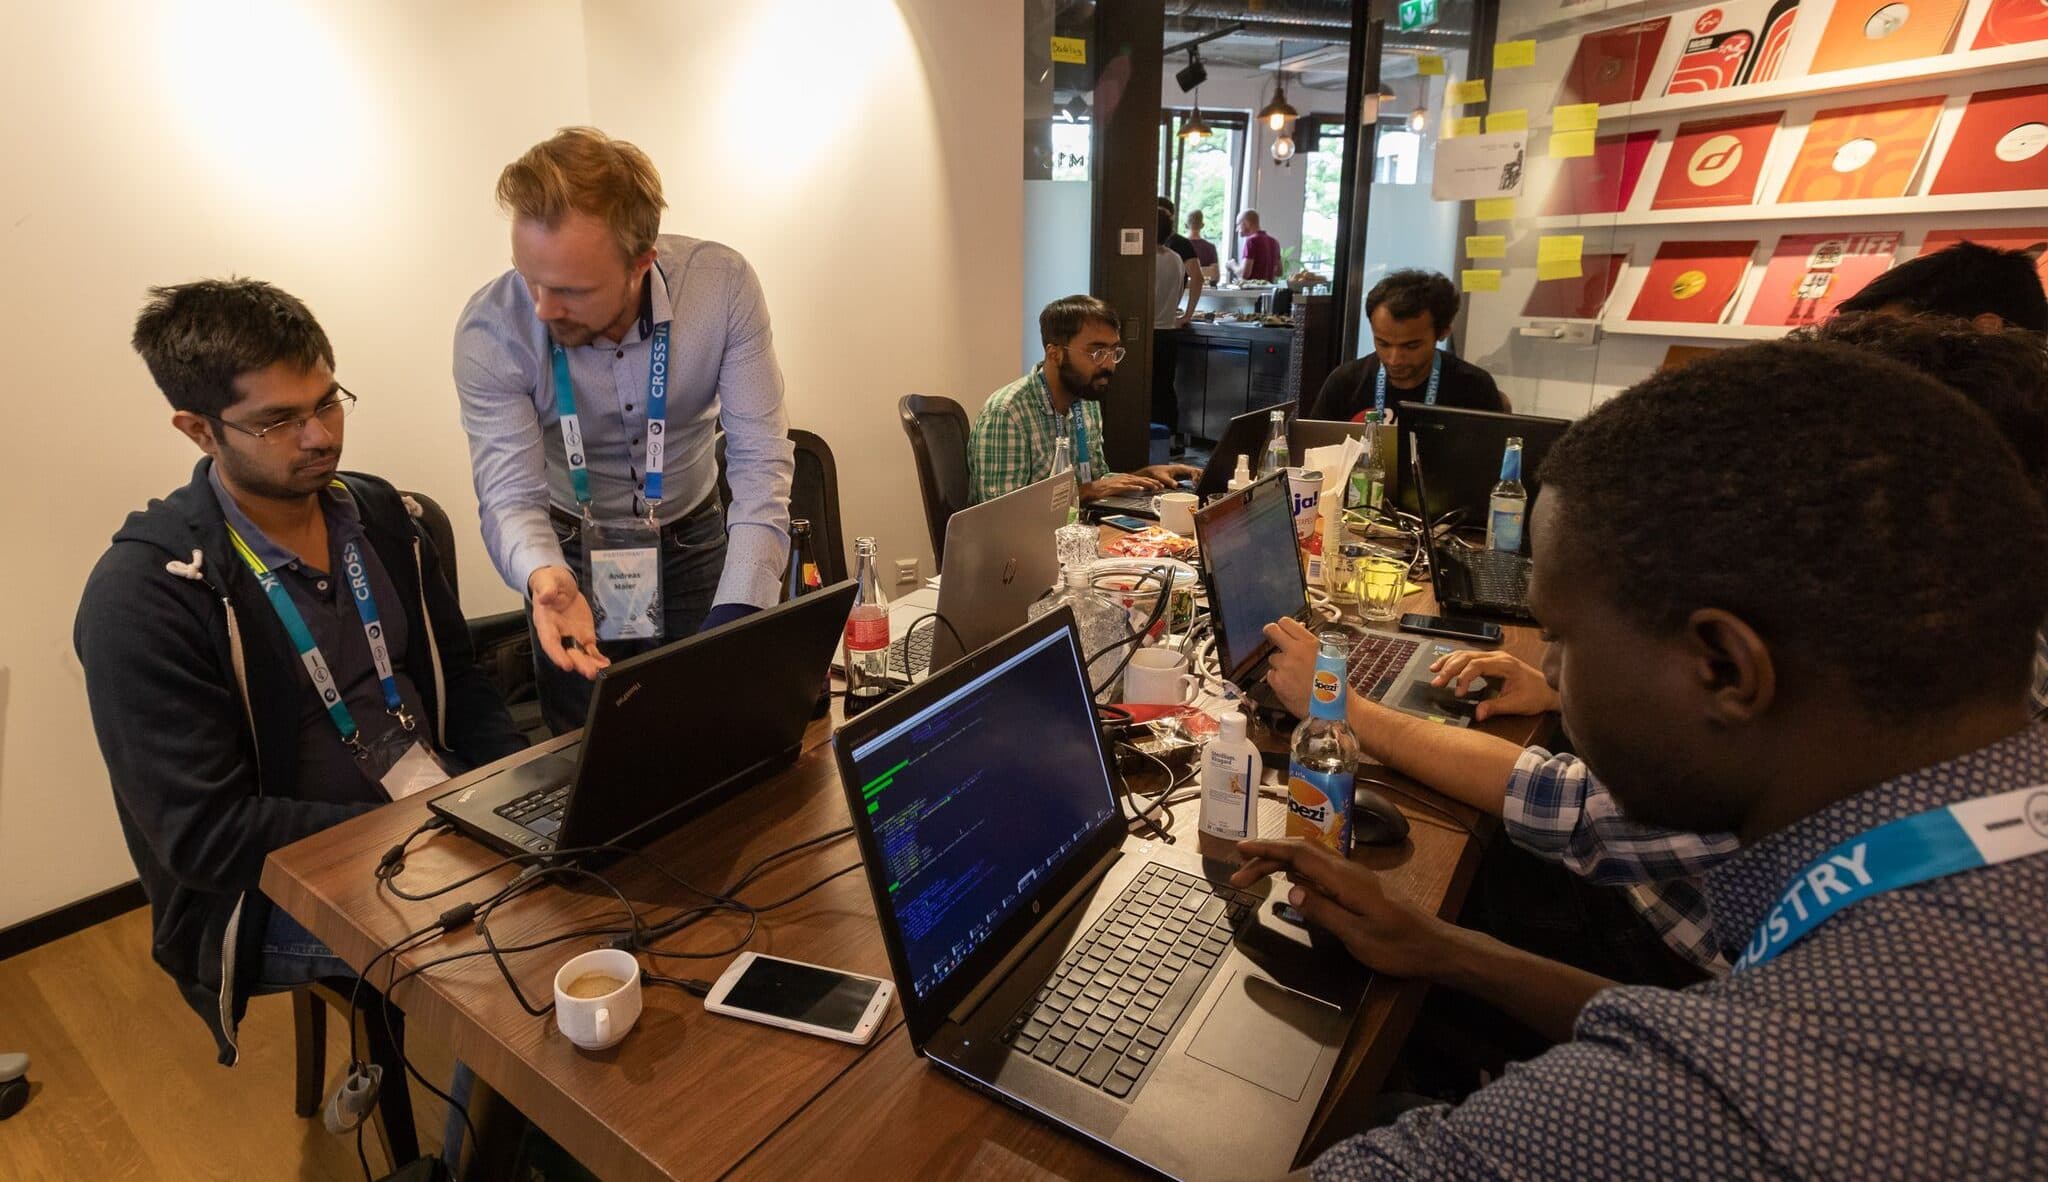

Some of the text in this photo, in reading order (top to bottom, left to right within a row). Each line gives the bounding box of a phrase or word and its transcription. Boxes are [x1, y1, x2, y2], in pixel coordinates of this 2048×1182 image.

[1293, 490, 1319, 516] ja!
[1314, 678, 1337, 692] Spezi
[1288, 790, 1326, 823] pezi
